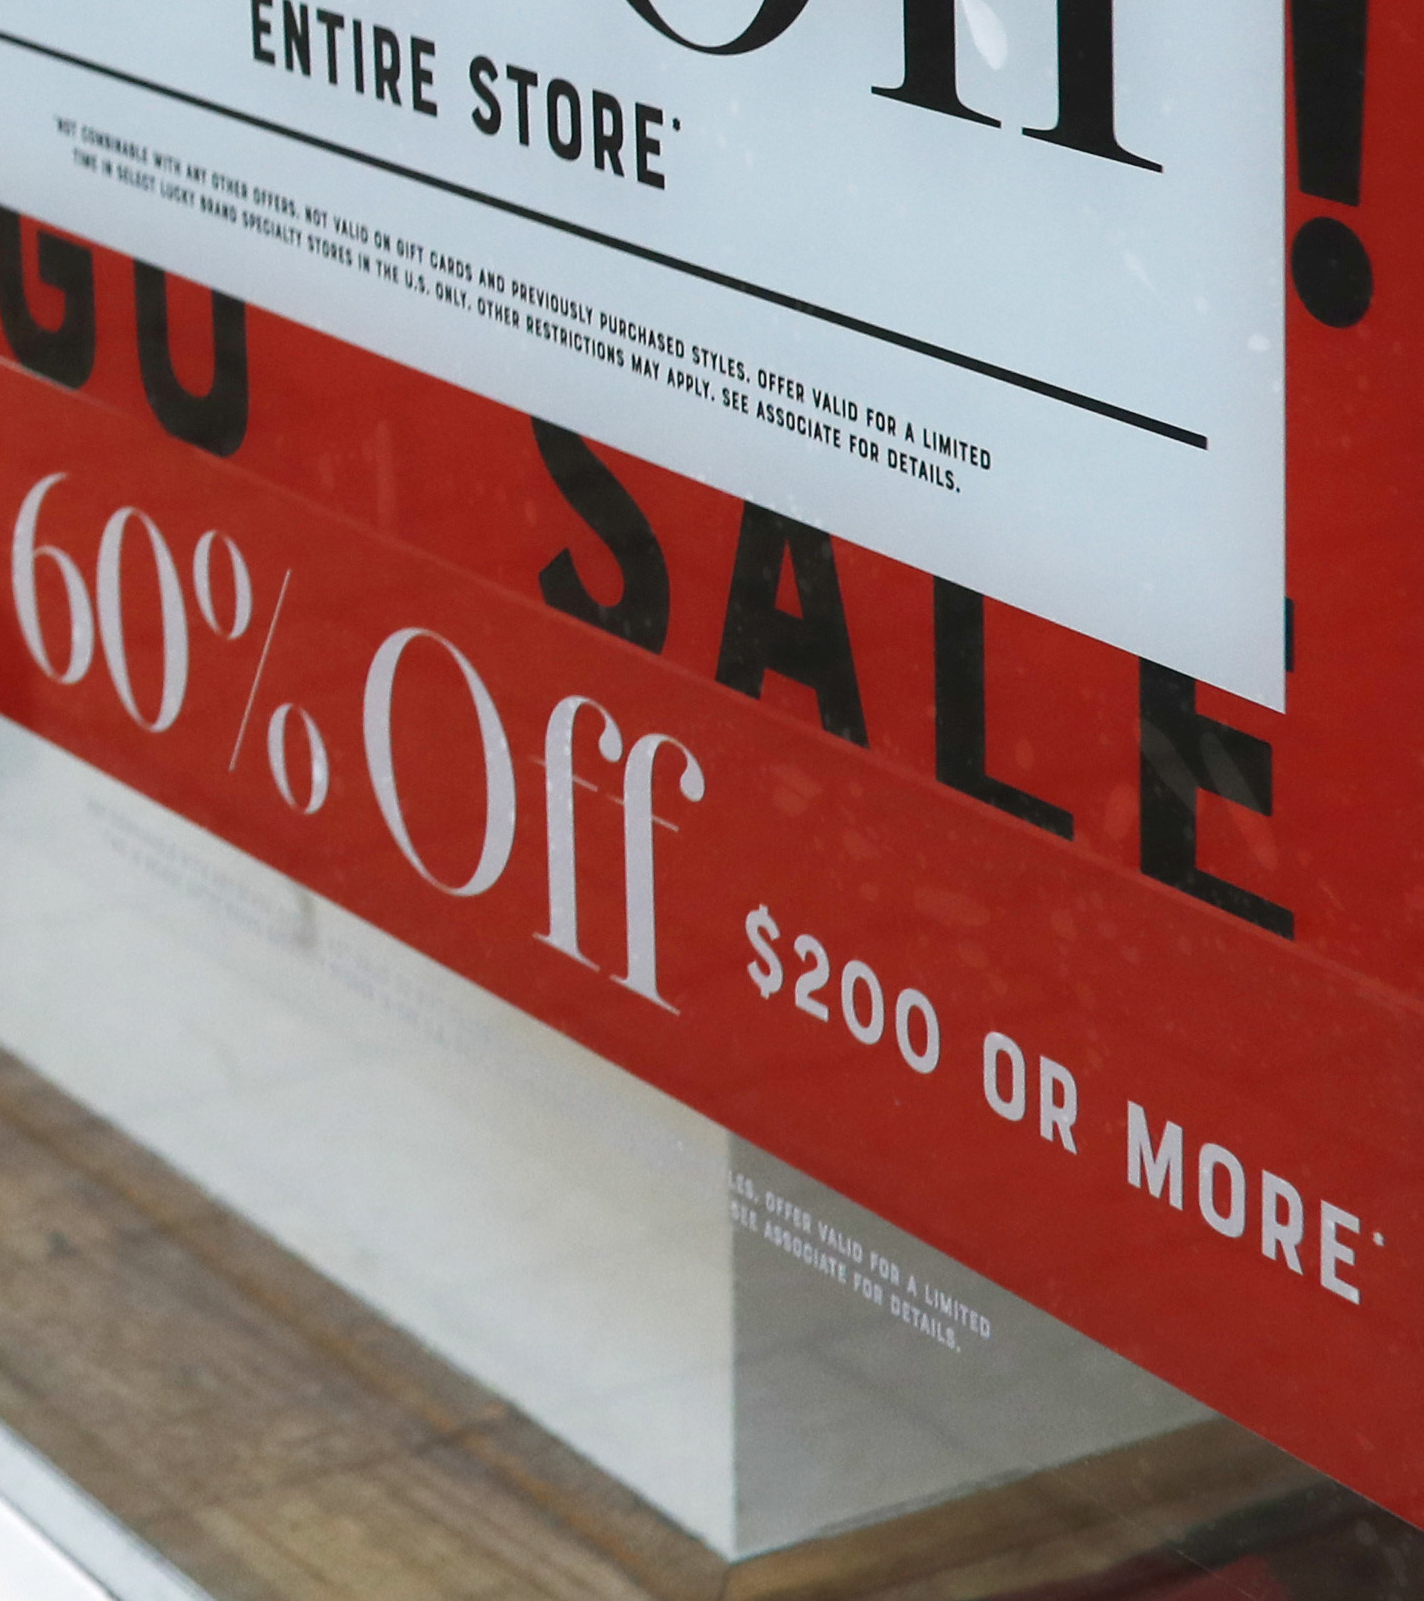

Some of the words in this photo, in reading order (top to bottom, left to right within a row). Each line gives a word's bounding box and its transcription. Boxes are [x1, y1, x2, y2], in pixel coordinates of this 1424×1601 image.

[73, 147, 96, 172] TIME
[101, 157, 111, 178] IN
[117, 163, 154, 194] SELECT
[160, 179, 194, 208] LUCKY
[200, 194, 236, 224] BRAND
[242, 209, 301, 248] SPECIALTY
[307, 233, 352, 267] STORES
[358, 252, 369, 274] IN
[376, 258, 398, 284] THE
[404, 269, 429, 296] U.S.
[435, 280, 471, 311] ONLY.
[477, 295, 518, 329] OTHER
[526, 313, 624, 367] RESTRICTIONS
[633, 353, 660, 381] MAY
[667, 365, 714, 401] APPLY.
[722, 385, 749, 414] SEE
[756, 398, 840, 447] ASSOCIATE
[849, 432, 878, 462] FOR
[887, 446, 960, 492] DETAILS.
[80, 123, 147, 164] COMBINABLE
[154, 150, 180, 176] WITH
[184, 161, 206, 186] ANY
[212, 171, 246, 200] OTHER
[253, 186, 298, 219] OFFERS.
[304, 204, 328, 230] NOT
[333, 214, 367, 244] VALID
[374, 229, 390, 253] ON
[396, 237, 423, 265] GIFT
[430, 250, 472, 283] CARDS
[478, 267, 504, 294] AND
[511, 279, 592, 326] PREVIOUSLY
[600, 311, 684, 360] PURCHASED
[692, 344, 750, 384] STYLES.
[757, 368, 804, 403] OFFER
[812, 388, 857, 423] VALID
[865, 407, 895, 437] FOR
[904, 421, 914, 444] A
[923, 428, 990, 471] LIMITED
[10, 471, 330, 815] 60%
[362, 627, 705, 1016] Off
[744, 903, 941, 1075] $200
[982, 1030, 1078, 1155] OR
[764, 1218, 847, 1285] ASSOCIATE
[854, 1270, 882, 1306] FOR
[890, 1292, 960, 1354] DETAILS.
[765, 1189, 811, 1234] OFFER
[818, 1220, 862, 1265] VALID
[870, 1250, 899, 1286] FOR
[906, 1273, 917, 1297] A
[924, 1283, 990, 1342] LIMITED
